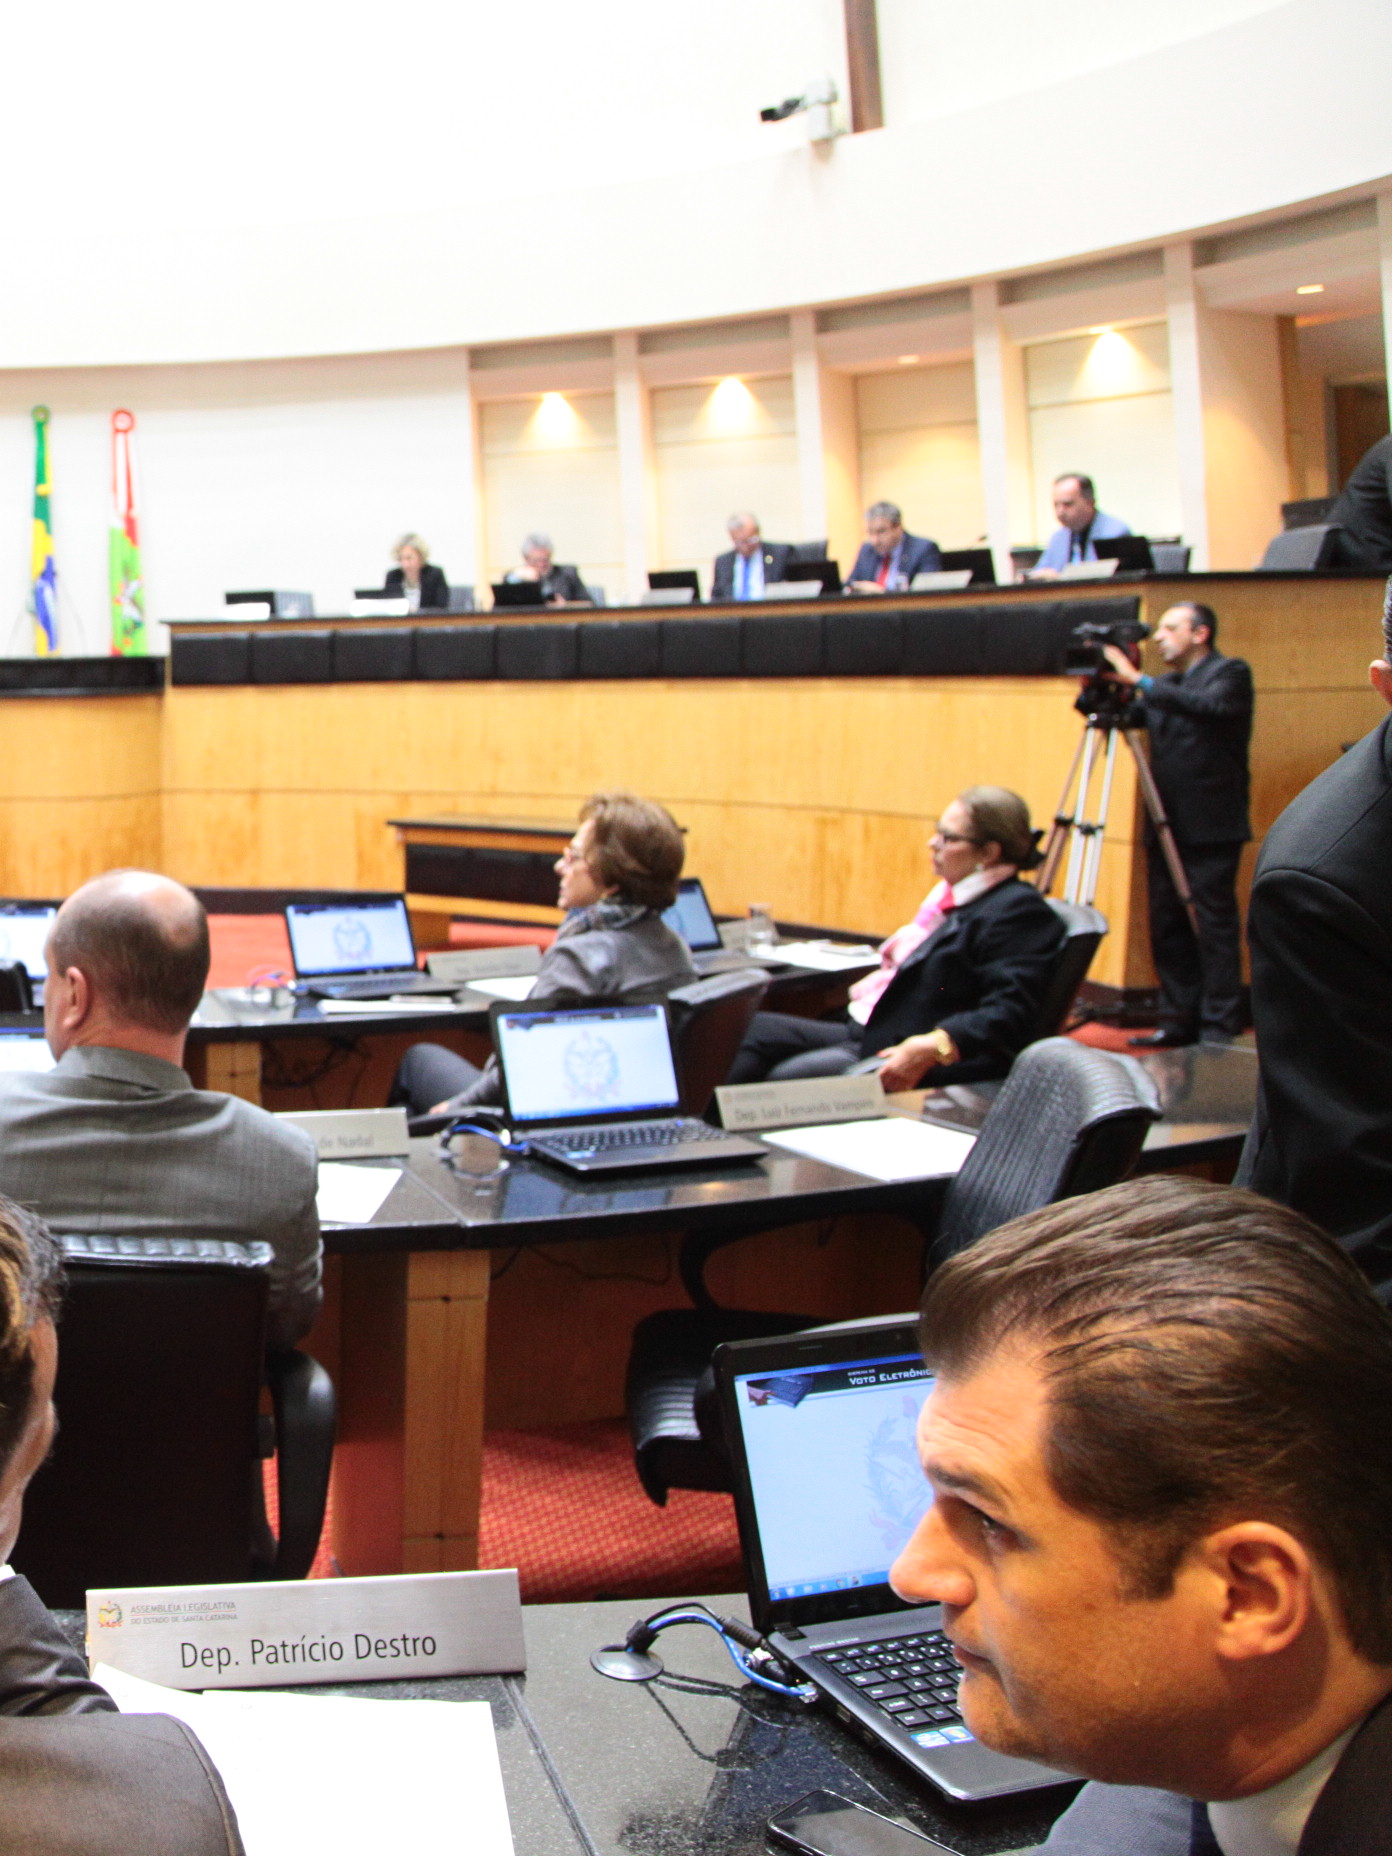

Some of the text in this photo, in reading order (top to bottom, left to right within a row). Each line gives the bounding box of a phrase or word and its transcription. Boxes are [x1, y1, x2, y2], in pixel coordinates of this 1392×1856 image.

[849, 1376, 876, 1385] VOTO
[879, 1368, 933, 1382] ELETRÔNIC
[181, 1632, 437, 1673] Dep. Patrício Destro
